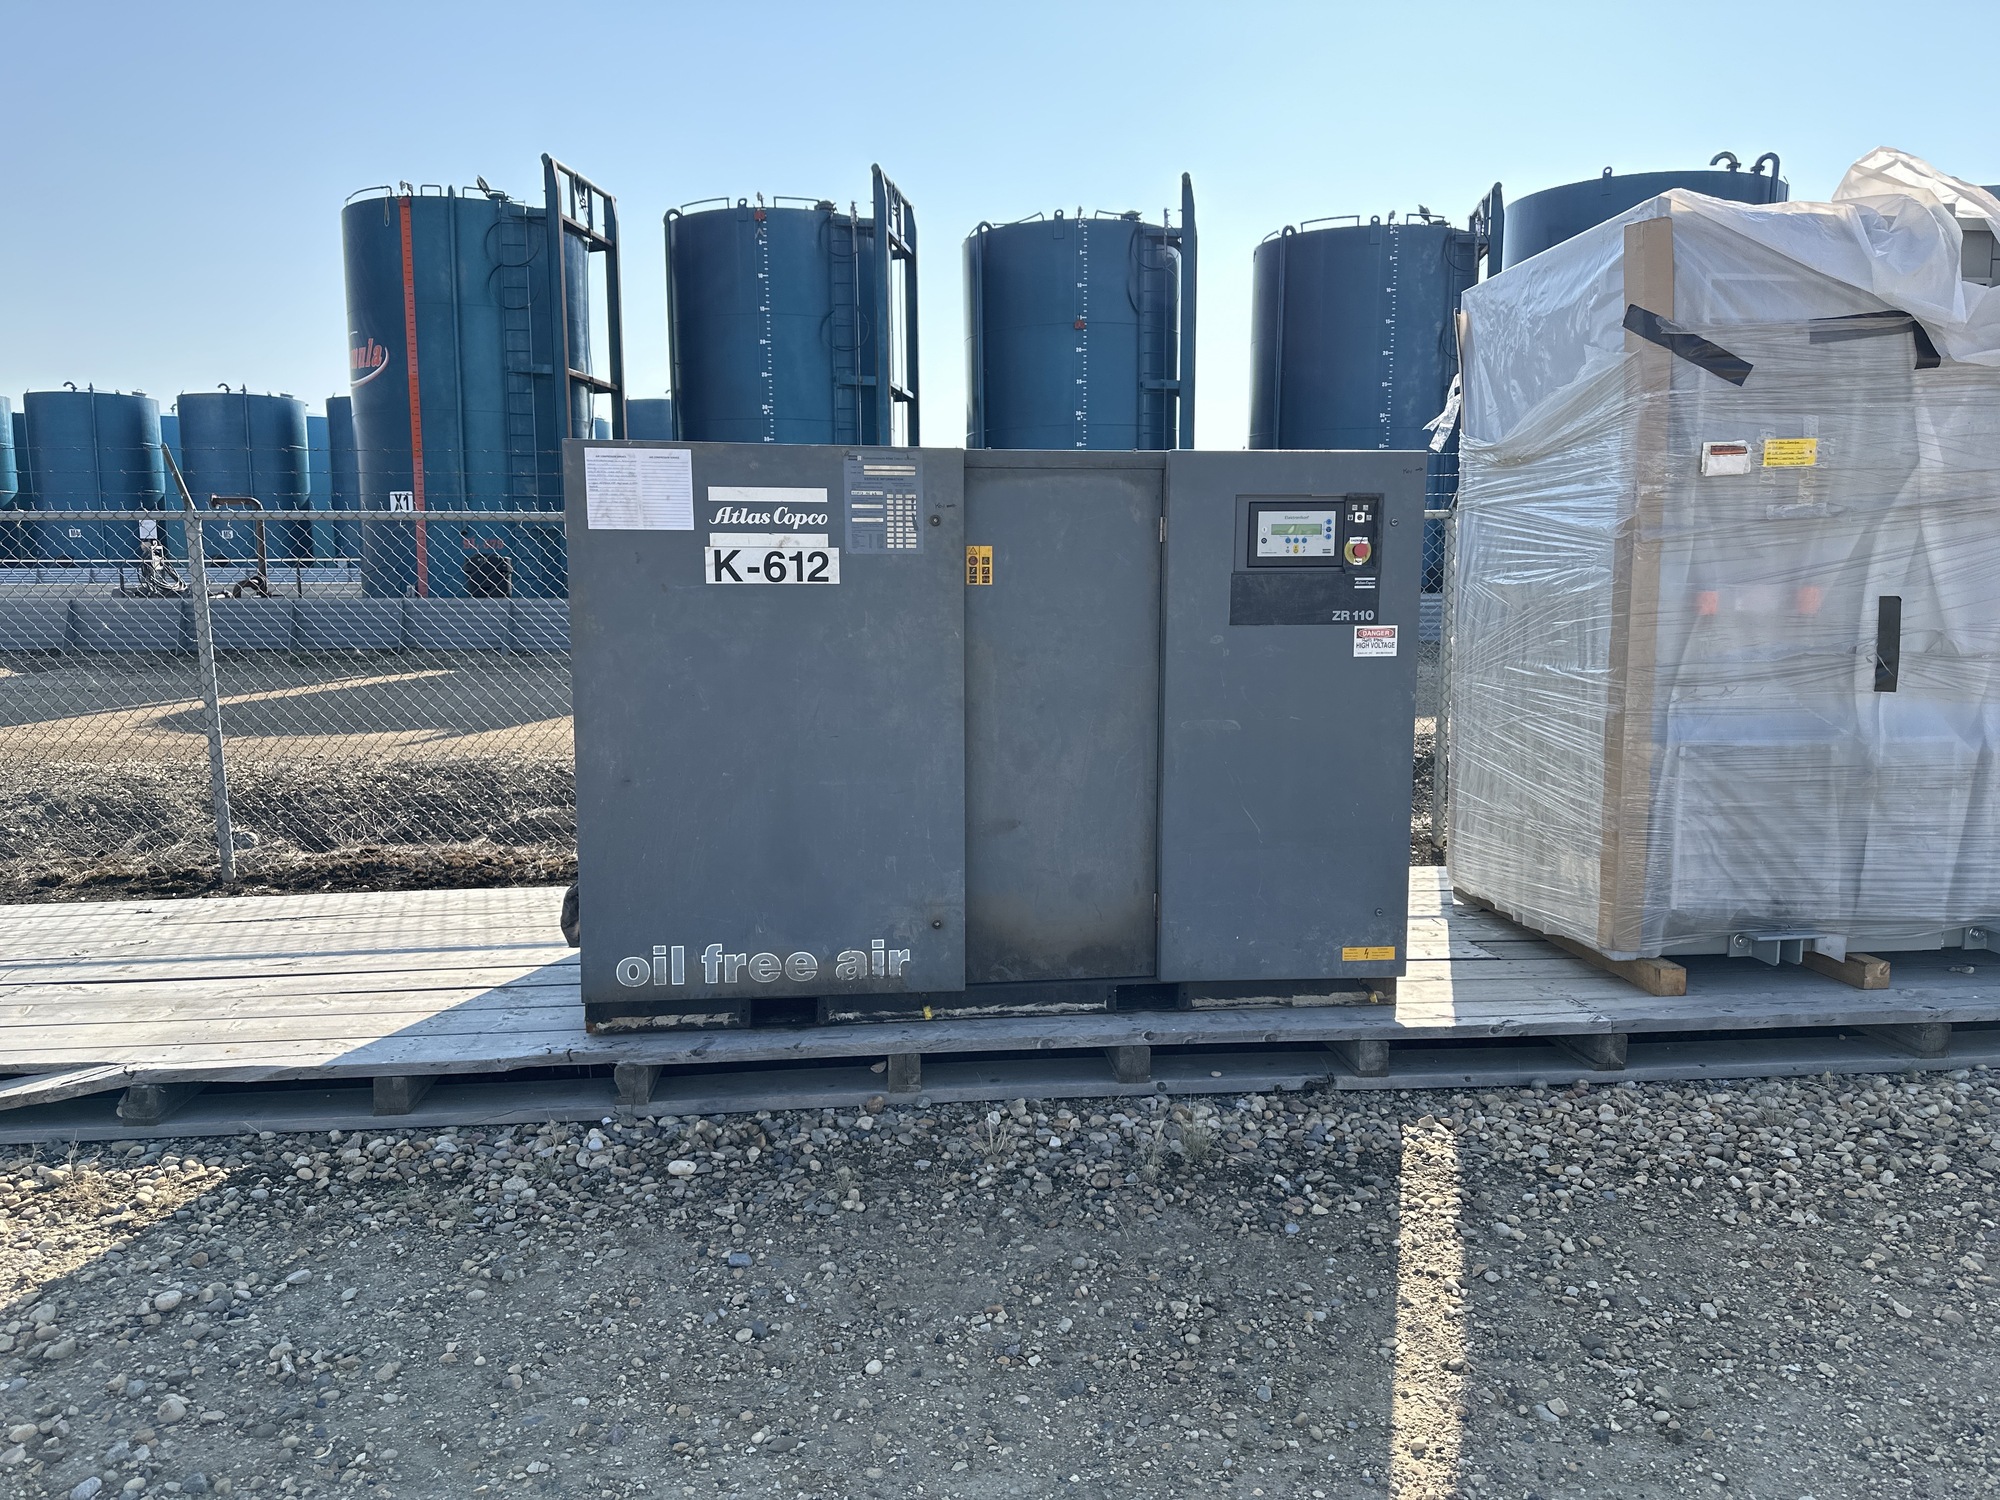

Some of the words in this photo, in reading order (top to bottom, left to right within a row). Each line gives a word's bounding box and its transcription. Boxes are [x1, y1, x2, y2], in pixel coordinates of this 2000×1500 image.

[394, 493, 409, 511] X1
[709, 506, 771, 525] Atlas
[773, 506, 828, 530] Copco
[714, 550, 829, 582] K-612
[1332, 610, 1350, 621] ZR
[1353, 610, 1375, 621] 110
[615, 945, 686, 988] oil
[701, 943, 819, 984] free
[835, 938, 911, 982] air
